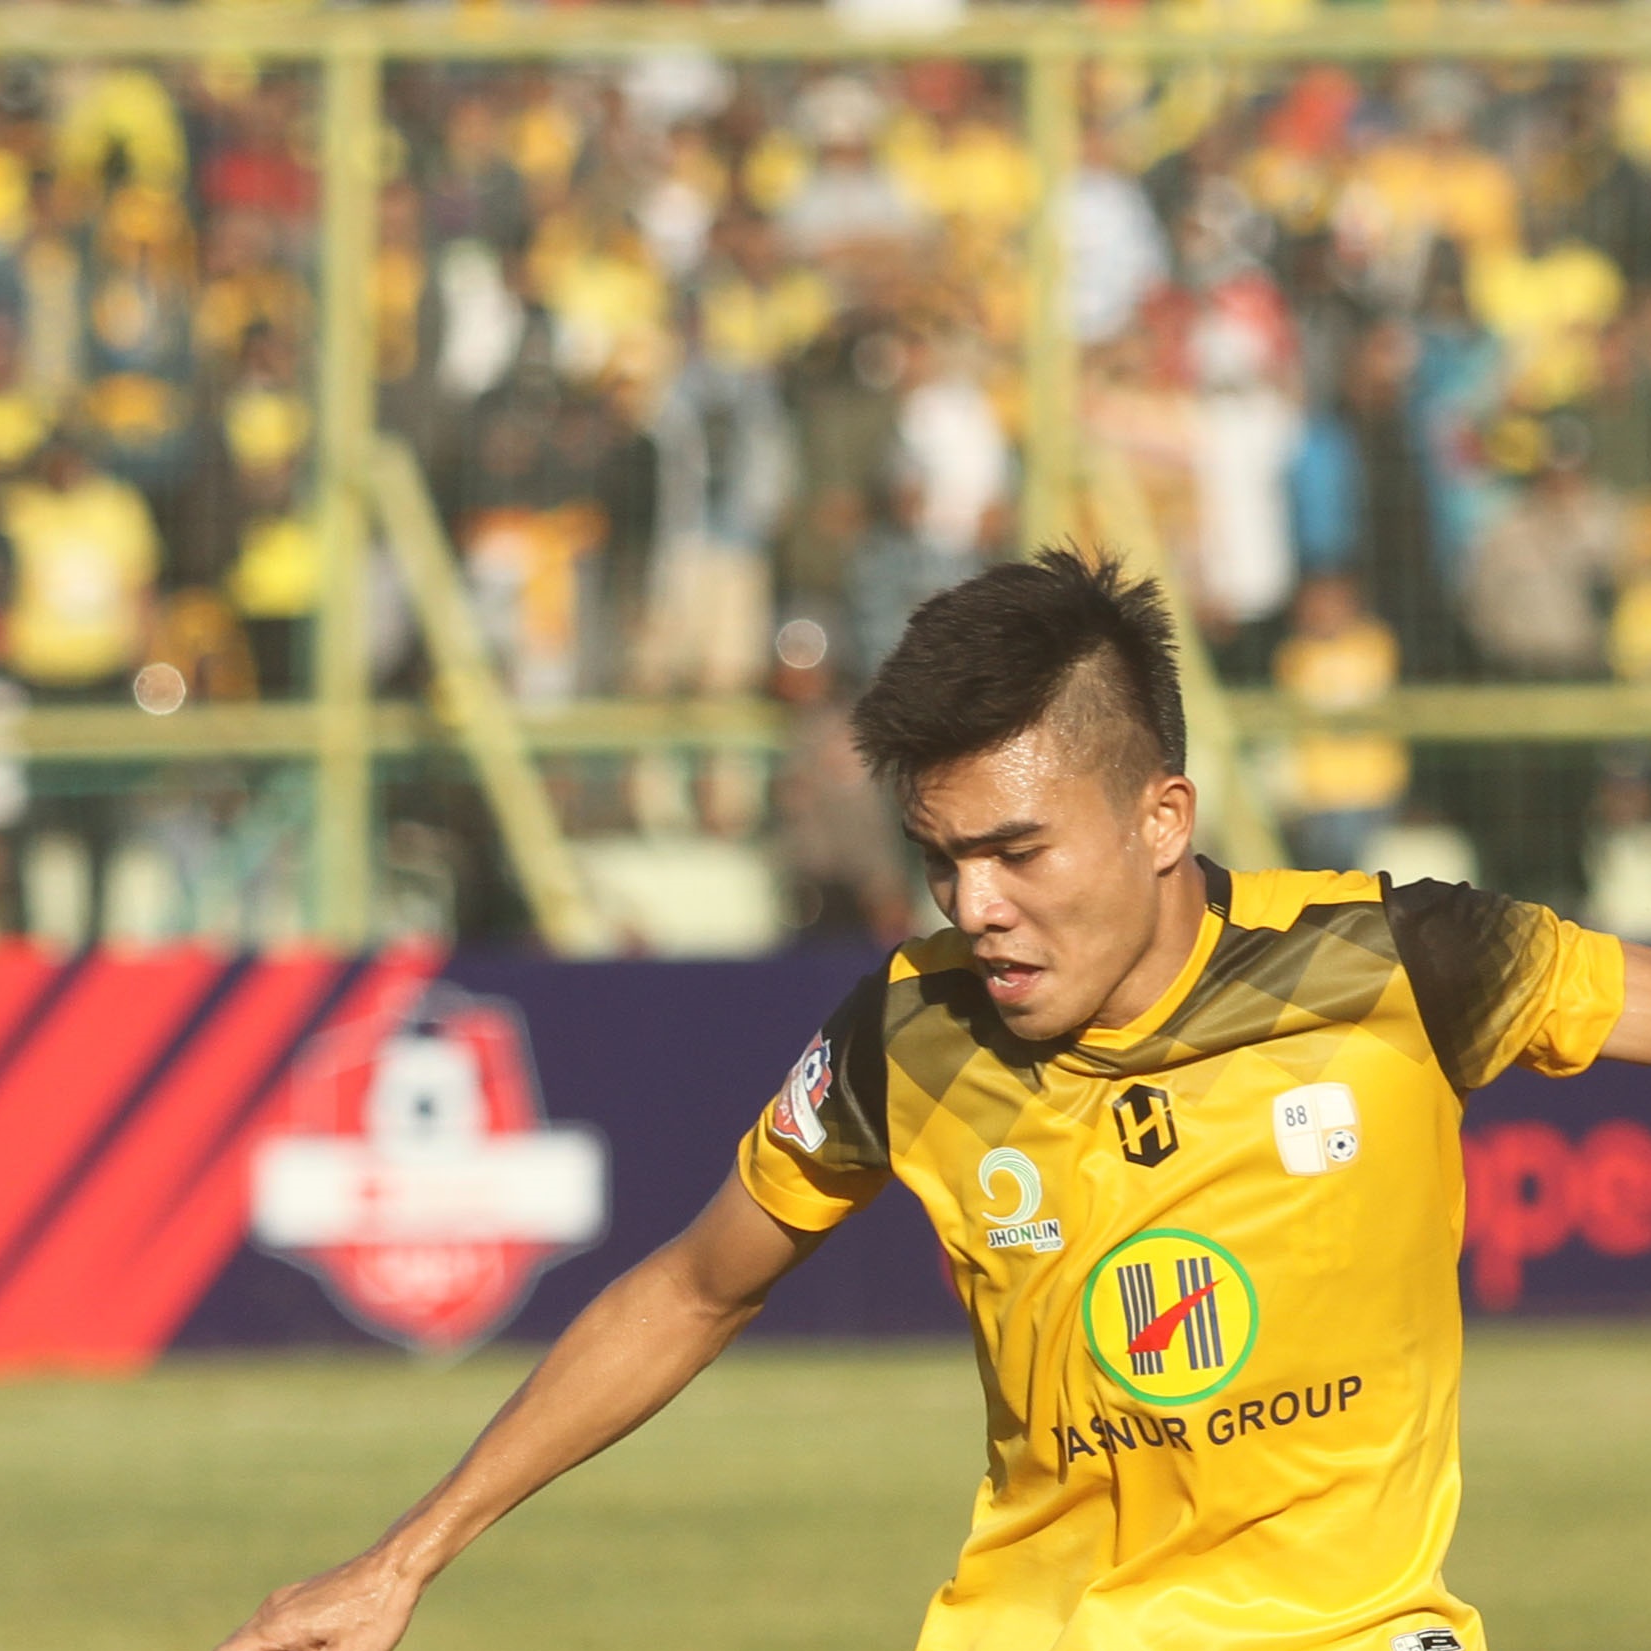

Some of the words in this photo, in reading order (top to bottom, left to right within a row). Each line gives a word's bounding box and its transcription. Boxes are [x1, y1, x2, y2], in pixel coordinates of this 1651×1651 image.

[1284, 1104, 1308, 1127] 88
[989, 1220, 1060, 1247] JHONLIN
[1206, 1375, 1363, 1446] GROUP
